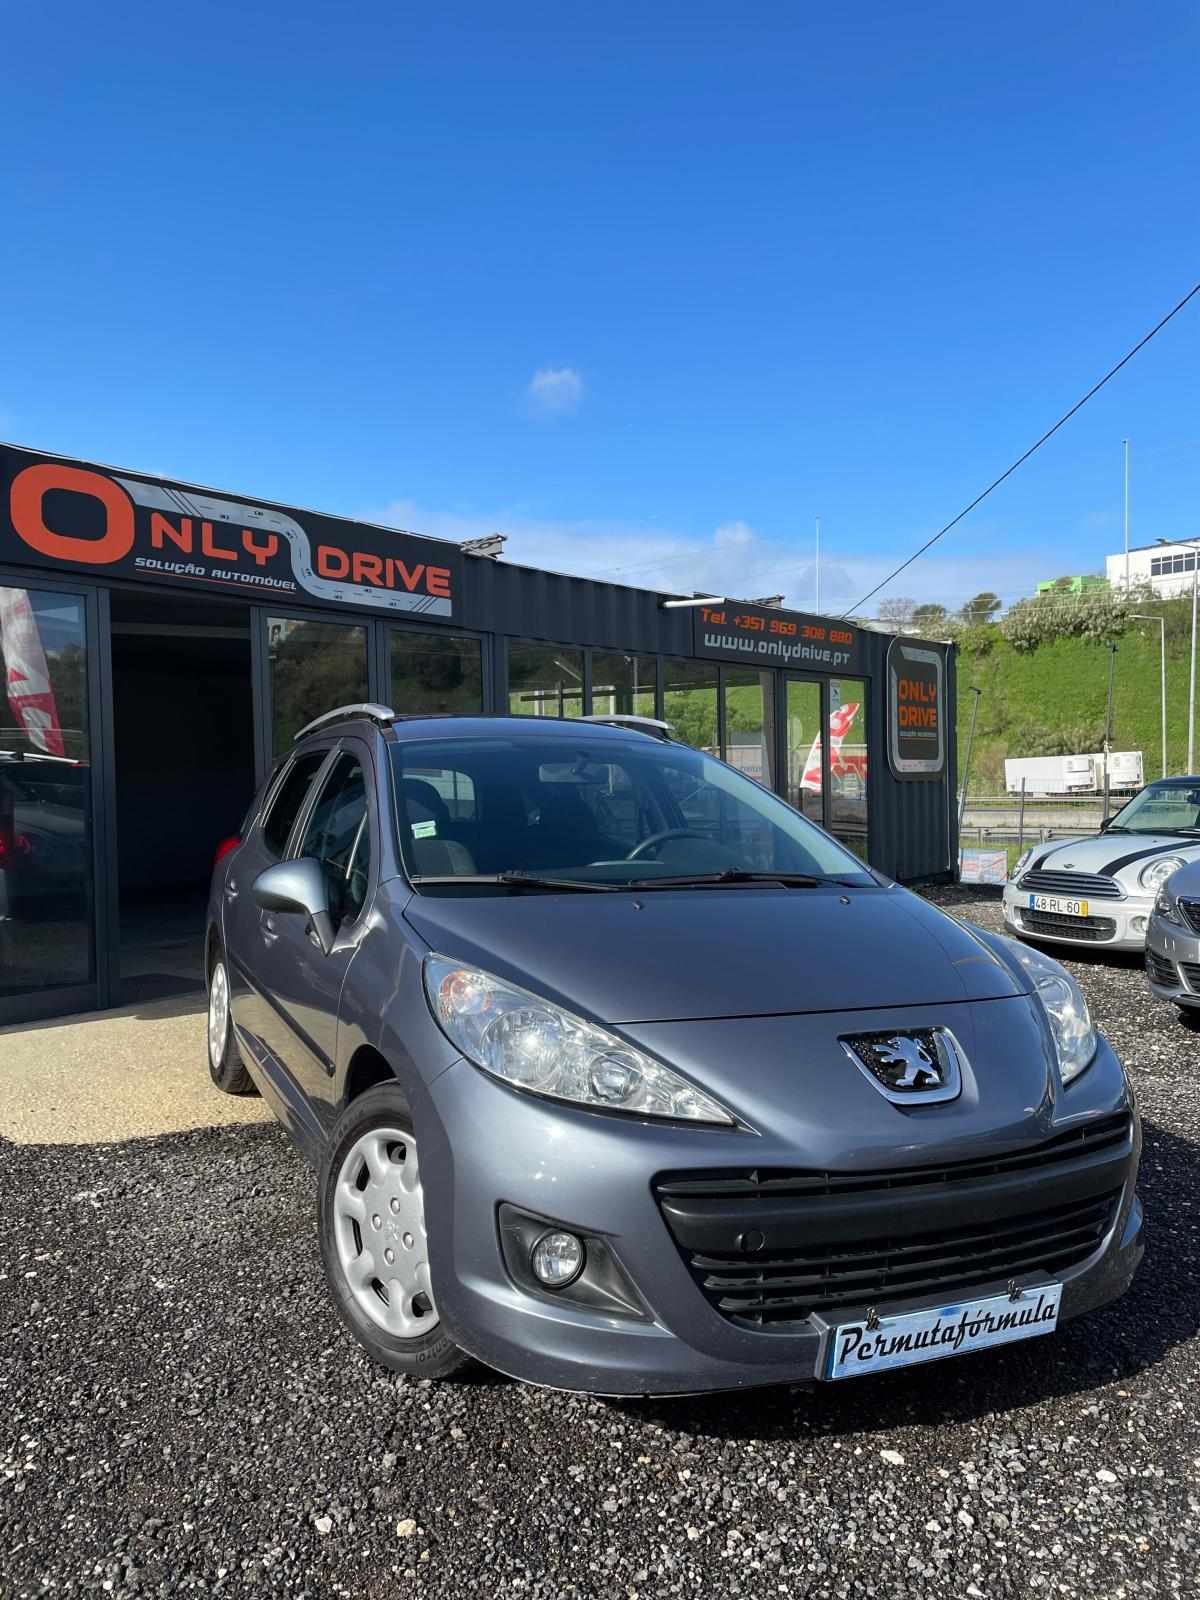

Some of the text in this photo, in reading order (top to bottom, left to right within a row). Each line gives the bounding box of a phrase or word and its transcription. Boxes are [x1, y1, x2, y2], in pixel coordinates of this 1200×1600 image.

[9, 463, 451, 597] ONLY DRIVE
[134, 557, 297, 590] SOLUÇÃO AUTOMÓVEL
[769, 620, 797, 636] 969
[898, 678, 937, 703] ONLY
[898, 704, 937, 728] DRIVE
[838, 1294, 1057, 1365] Permutafórmula
